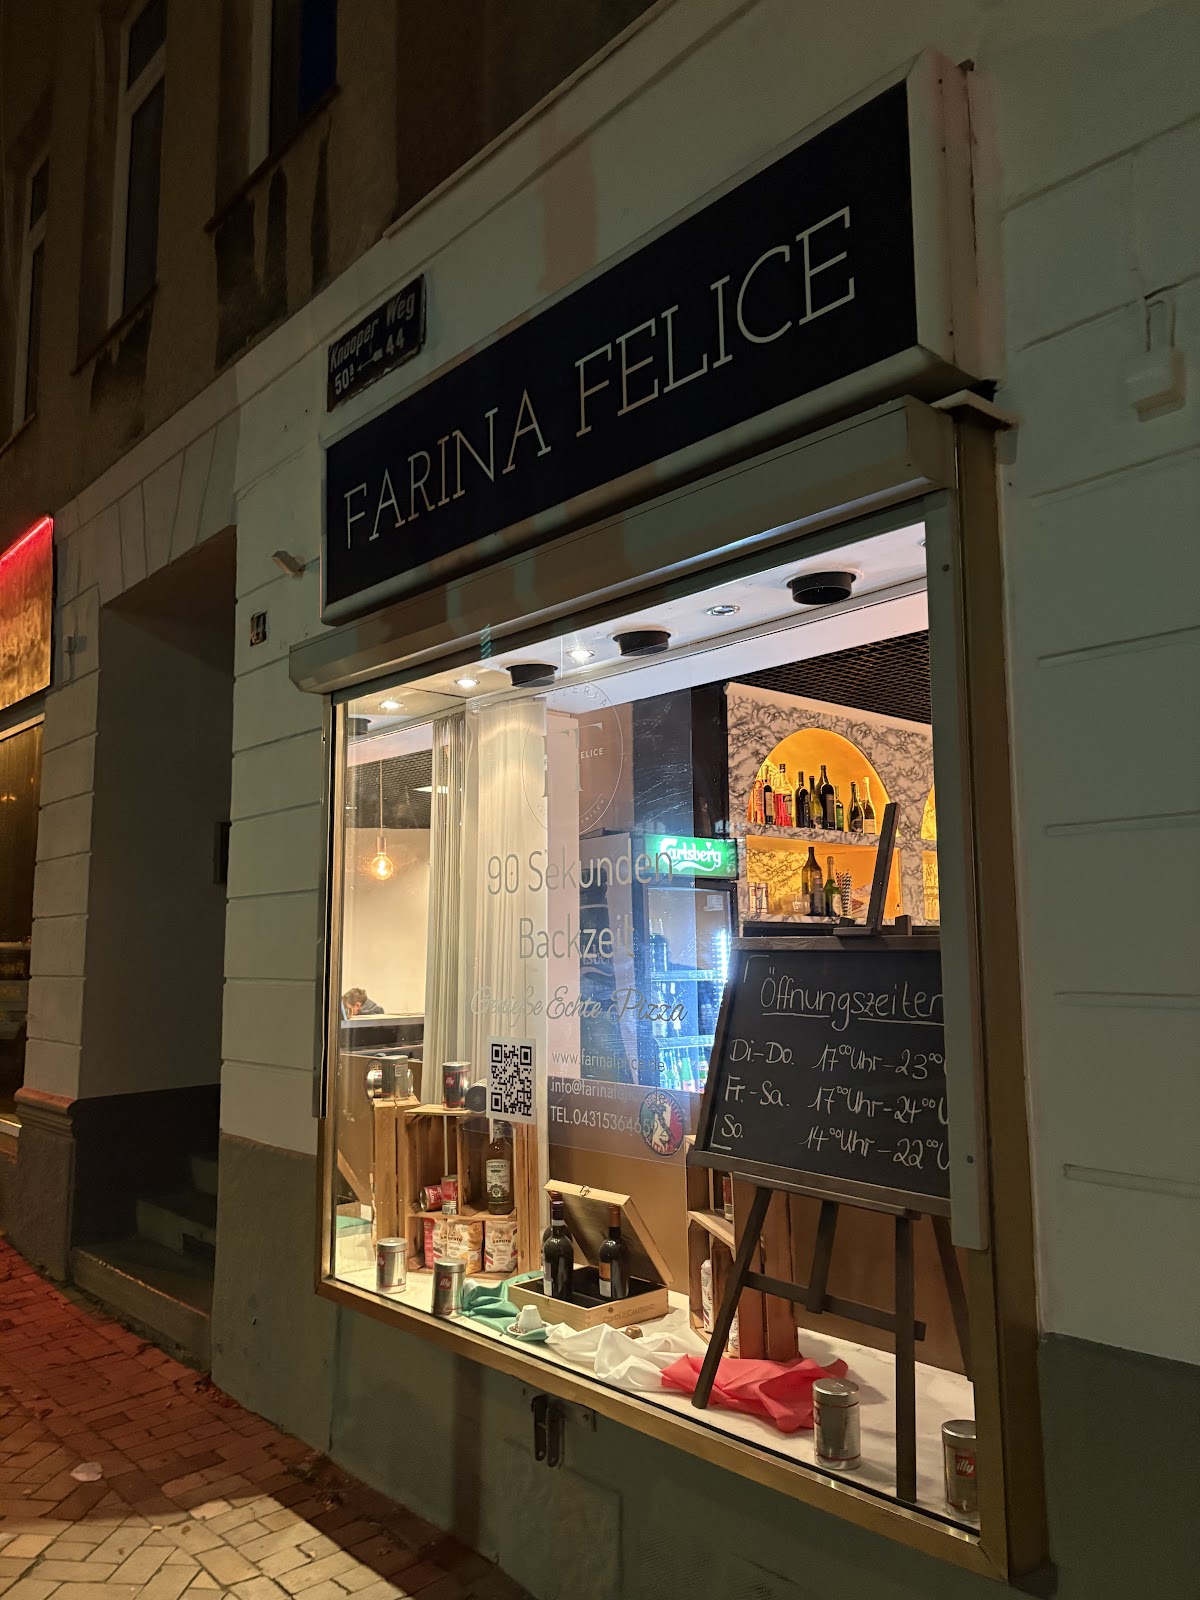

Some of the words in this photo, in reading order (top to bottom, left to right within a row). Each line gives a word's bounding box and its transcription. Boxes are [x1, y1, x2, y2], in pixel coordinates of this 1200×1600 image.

[329, 318, 380, 373] Knooper
[386, 292, 416, 327] Weg
[343, 388, 552, 550] FARINA
[574, 206, 856, 438] FELICE
[577, 747, 604, 759] ELICE
[487, 853, 519, 896] 90
[528, 838, 673, 893] Sekunden
[519, 914, 635, 960] Backzeit
[546, 986, 603, 1020] Echte
[607, 987, 688, 1023] Pizza
[439, 1277, 451, 1287] illy
[956, 1458, 975, 1476] illy
